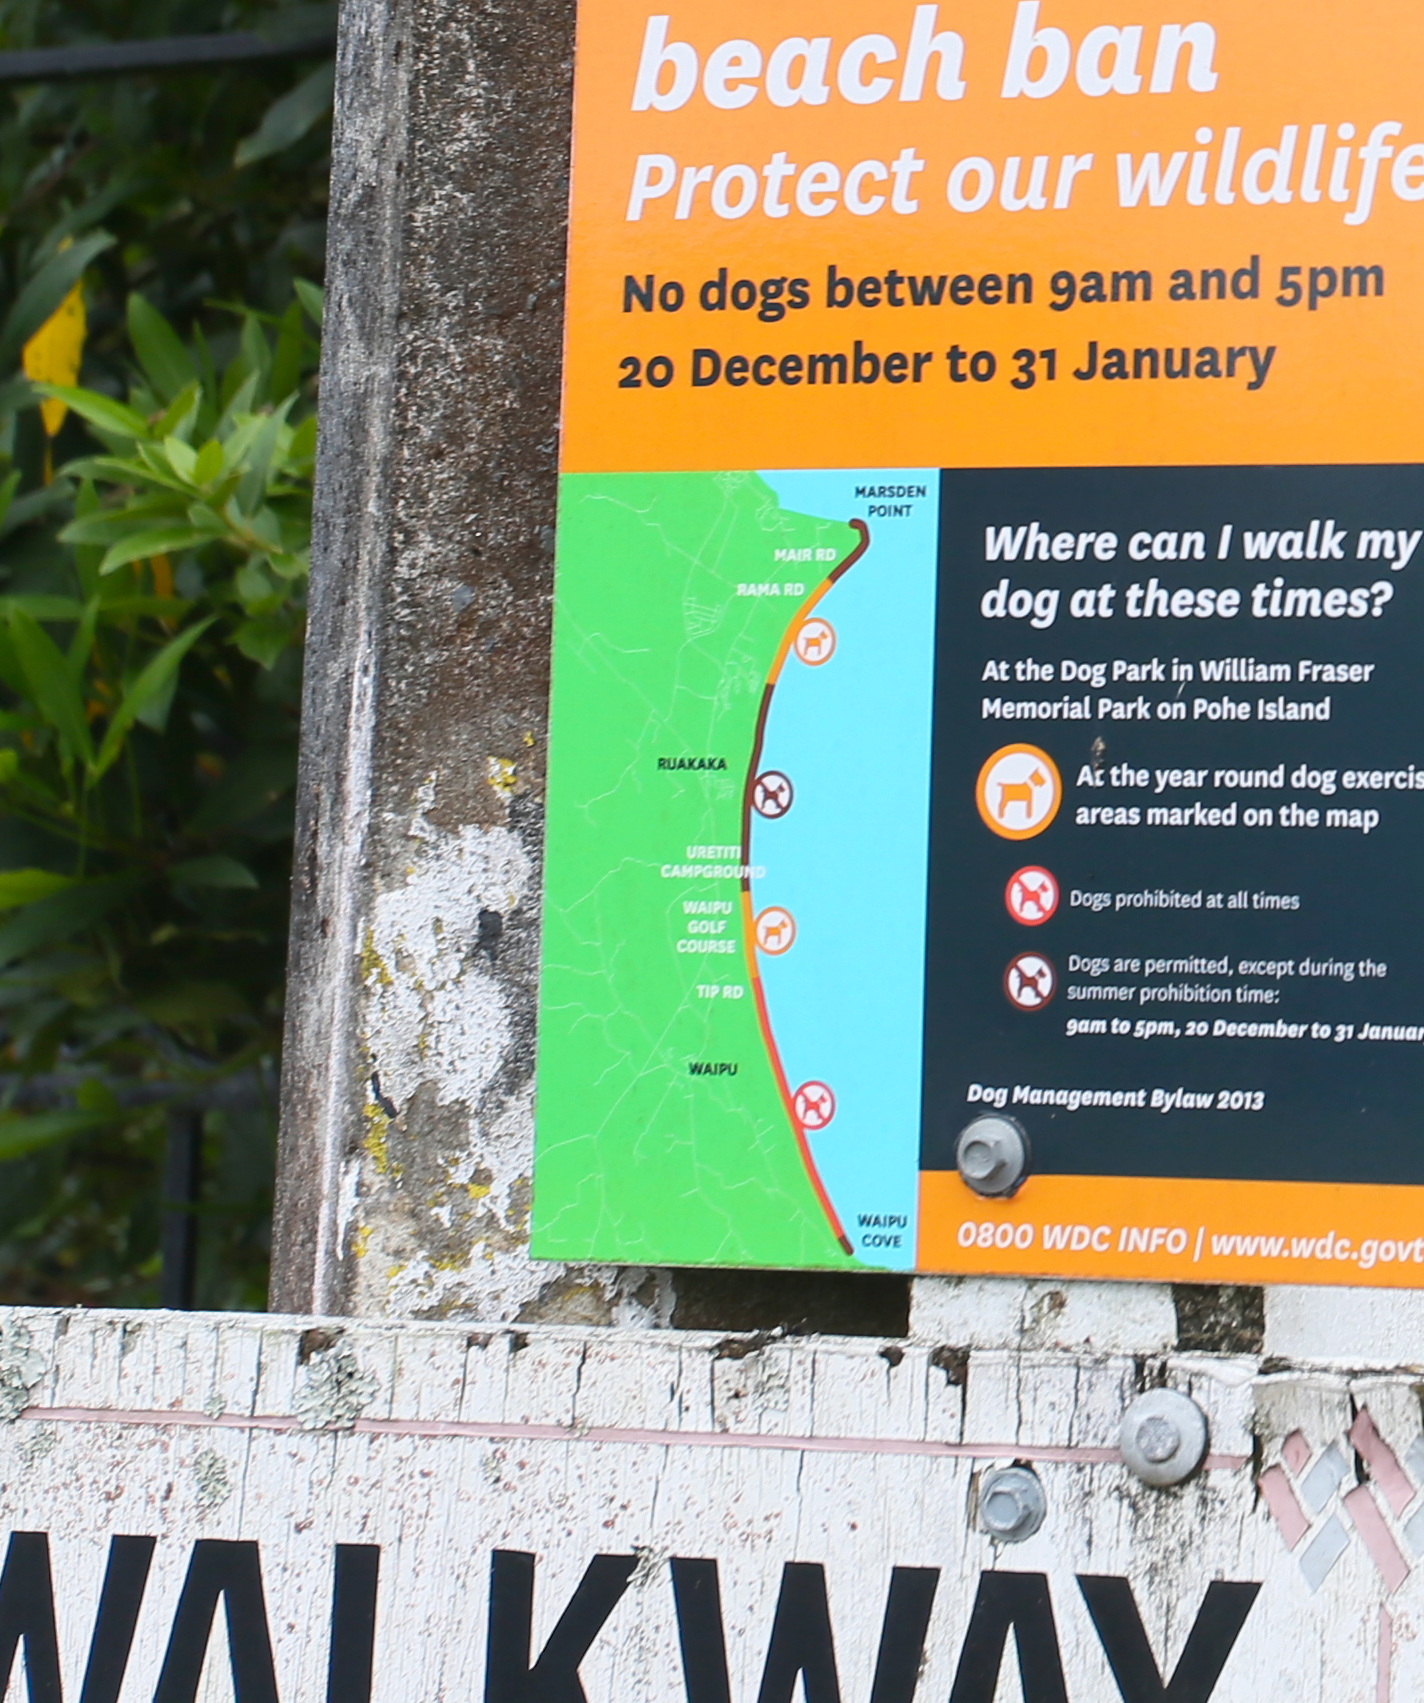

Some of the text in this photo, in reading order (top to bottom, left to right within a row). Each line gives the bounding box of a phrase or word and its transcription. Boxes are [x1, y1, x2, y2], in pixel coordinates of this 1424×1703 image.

[631, 0, 1218, 111] beach ban
[626, 148, 924, 220] Protect
[947, 154, 1093, 212] our
[623, 255, 1383, 322] No dogs between 9am and 5pm
[619, 341, 1276, 390] 20 December to 31 January
[855, 485, 926, 498] MARSDEN
[868, 505, 912, 517] POINT
[774, 548, 837, 562] MAIR RD
[986, 520, 1423, 570] Where can I walk my
[736, 582, 805, 597] RAMA RD
[981, 577, 1393, 628] dog at these times?
[982, 658, 1375, 687] At the Dog Park in William Fraser
[982, 696, 1330, 720] Memorial Park on Pohe Island
[658, 758, 727, 770] RUAKAKA
[1077, 765, 1104, 786] At
[1110, 763, 1149, 786] the
[1155, 770, 1208, 793] year
[1214, 764, 1284, 788] round
[1291, 764, 1337, 795] dog
[1076, 802, 1379, 833] areas marked on the map
[686, 845, 741, 859] URETITI
[660, 864, 767, 881] CAMPGROUND
[682, 901, 732, 915] WAIPU
[1070, 890, 1300, 911] Dogs prohibited at all times
[687, 920, 726, 934] GOLF
[676, 939, 736, 954] COURSE
[1069, 955, 1387, 981] Dogs are permitted, except during the
[696, 985, 744, 999] TIP RD
[1067, 983, 1279, 1005] summer prohibition time:
[1066, 1019, 1107, 1036] 9am
[1111, 1018, 1131, 1034] to
[1133, 1020, 1181, 1039] 5pm,
[1185, 1021, 1209, 1036] 20
[1213, 1019, 1308, 1038] December
[1311, 1022, 1331, 1038] to
[1334, 1024, 1354, 1042] 31
[689, 1062, 737, 1076] WAIPU
[967, 1084, 1264, 1113] Dog Management Bylaw 2013
[858, 1214, 907, 1228] WAIPU
[862, 1234, 901, 1248] COVE
[958, 1222, 1033, 1248] 0800
[1044, 1225, 1111, 1251] WDC
[1118, 1227, 1186, 1254] INFO
